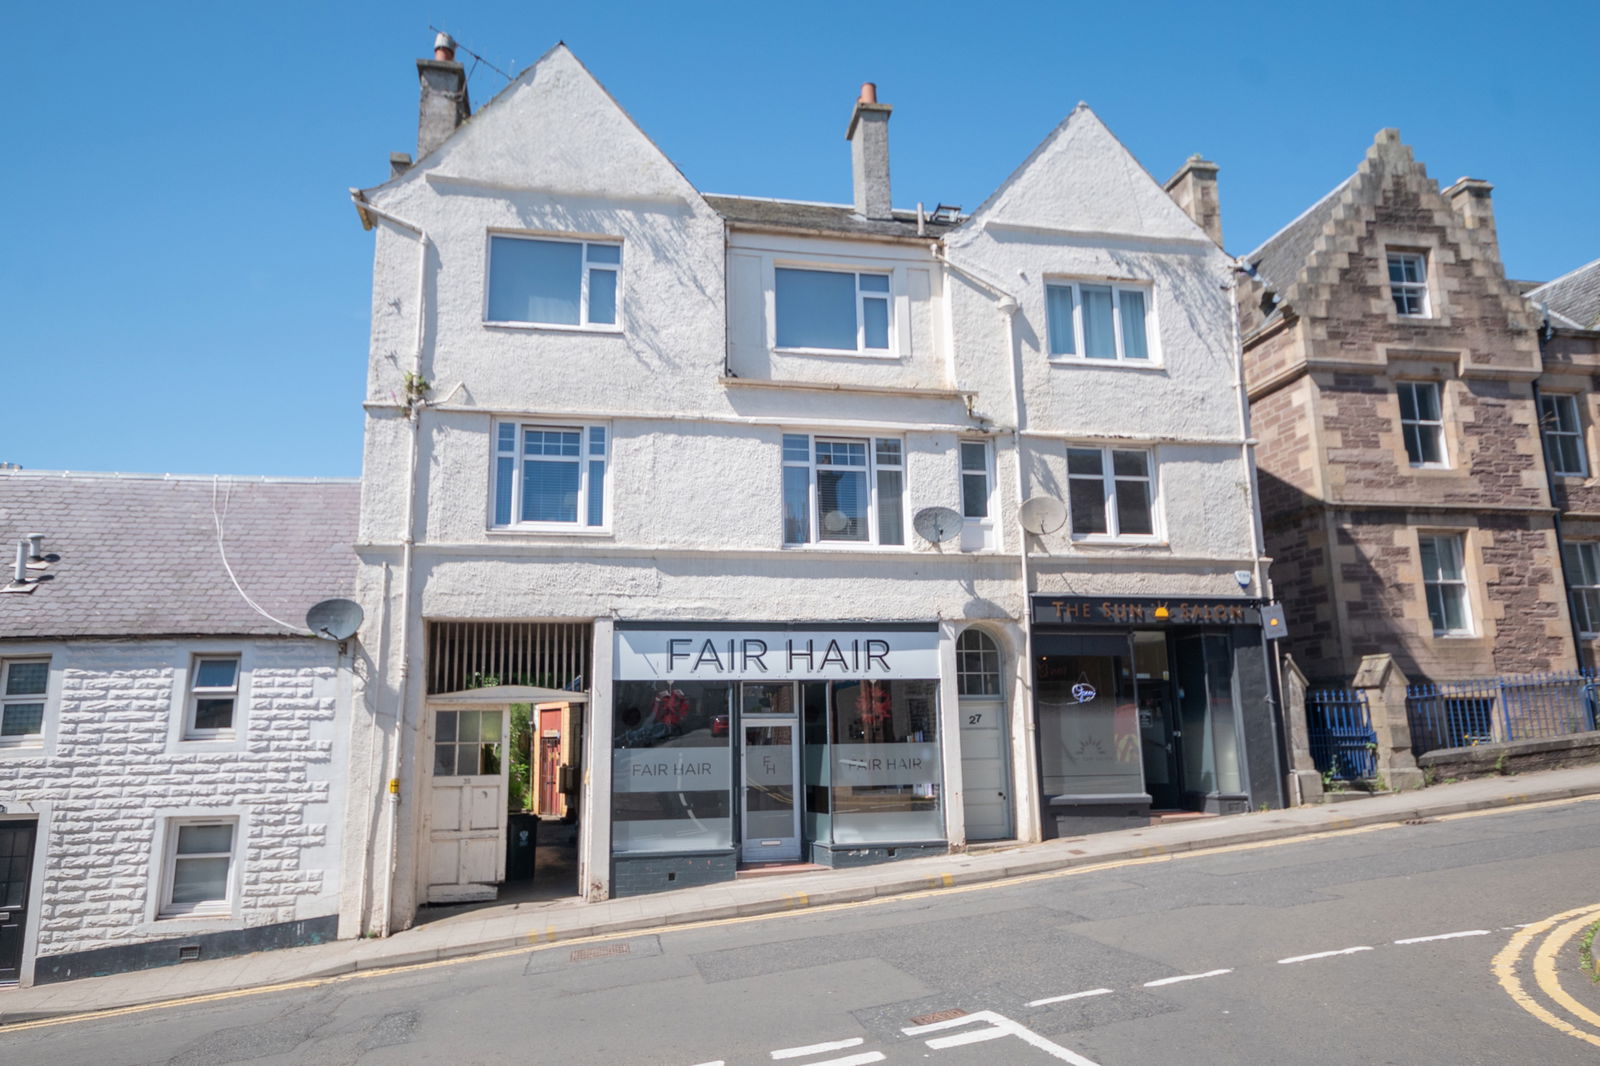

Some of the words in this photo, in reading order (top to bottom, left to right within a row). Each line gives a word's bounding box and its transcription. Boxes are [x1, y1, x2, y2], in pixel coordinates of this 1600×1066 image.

[1102, 601, 1144, 618] SUN
[1179, 602, 1245, 619] SALON
[666, 638, 769, 673] FAIR
[785, 638, 892, 673] HAIR
[969, 714, 982, 725] 27
[632, 763, 669, 777] FAIR
[673, 762, 712, 776] HAIR
[886, 757, 923, 771] HAIR
